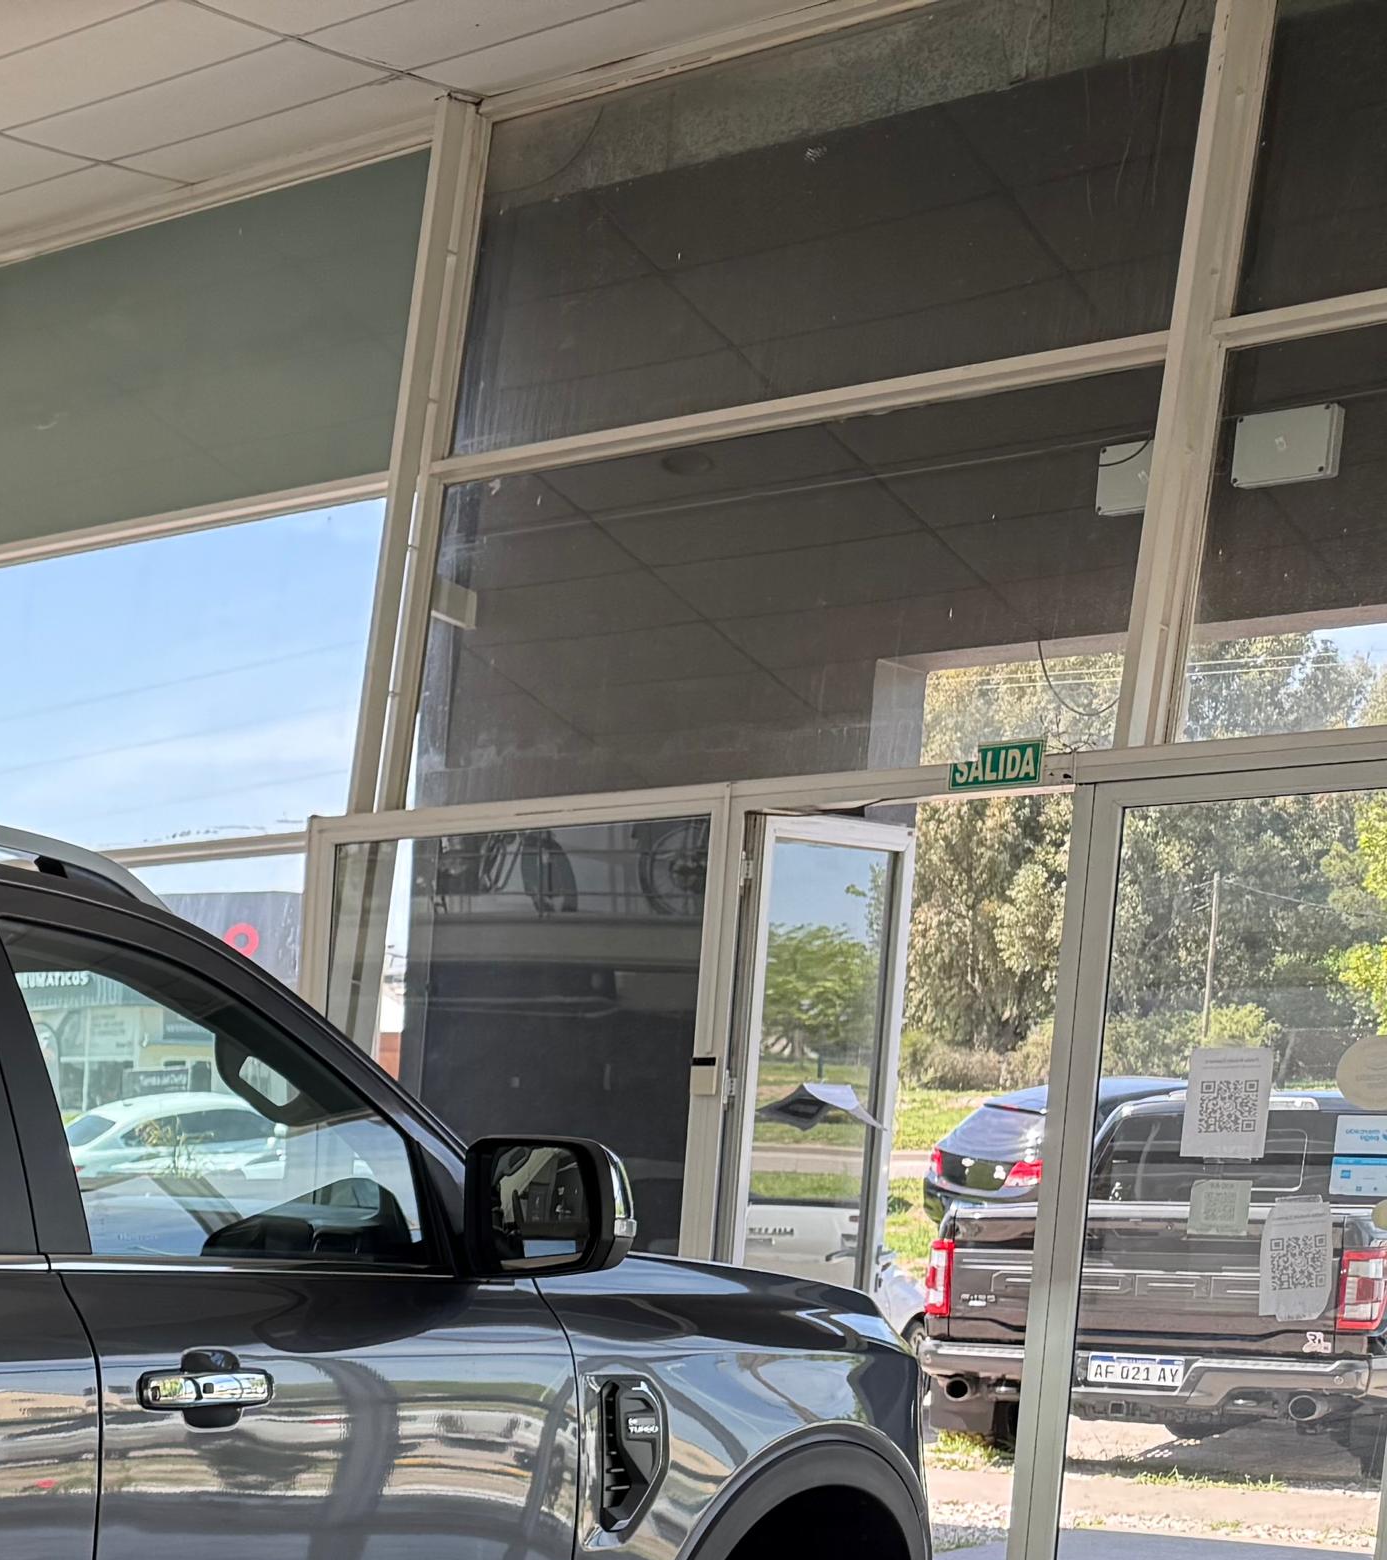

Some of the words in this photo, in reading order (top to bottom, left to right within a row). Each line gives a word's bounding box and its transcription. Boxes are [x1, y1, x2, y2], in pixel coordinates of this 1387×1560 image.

[955, 748, 1035, 784] SALIDA
[1094, 1364, 1116, 1379] AF
[1120, 1365, 1151, 1381] 021
[1157, 1367, 1179, 1383] AY
